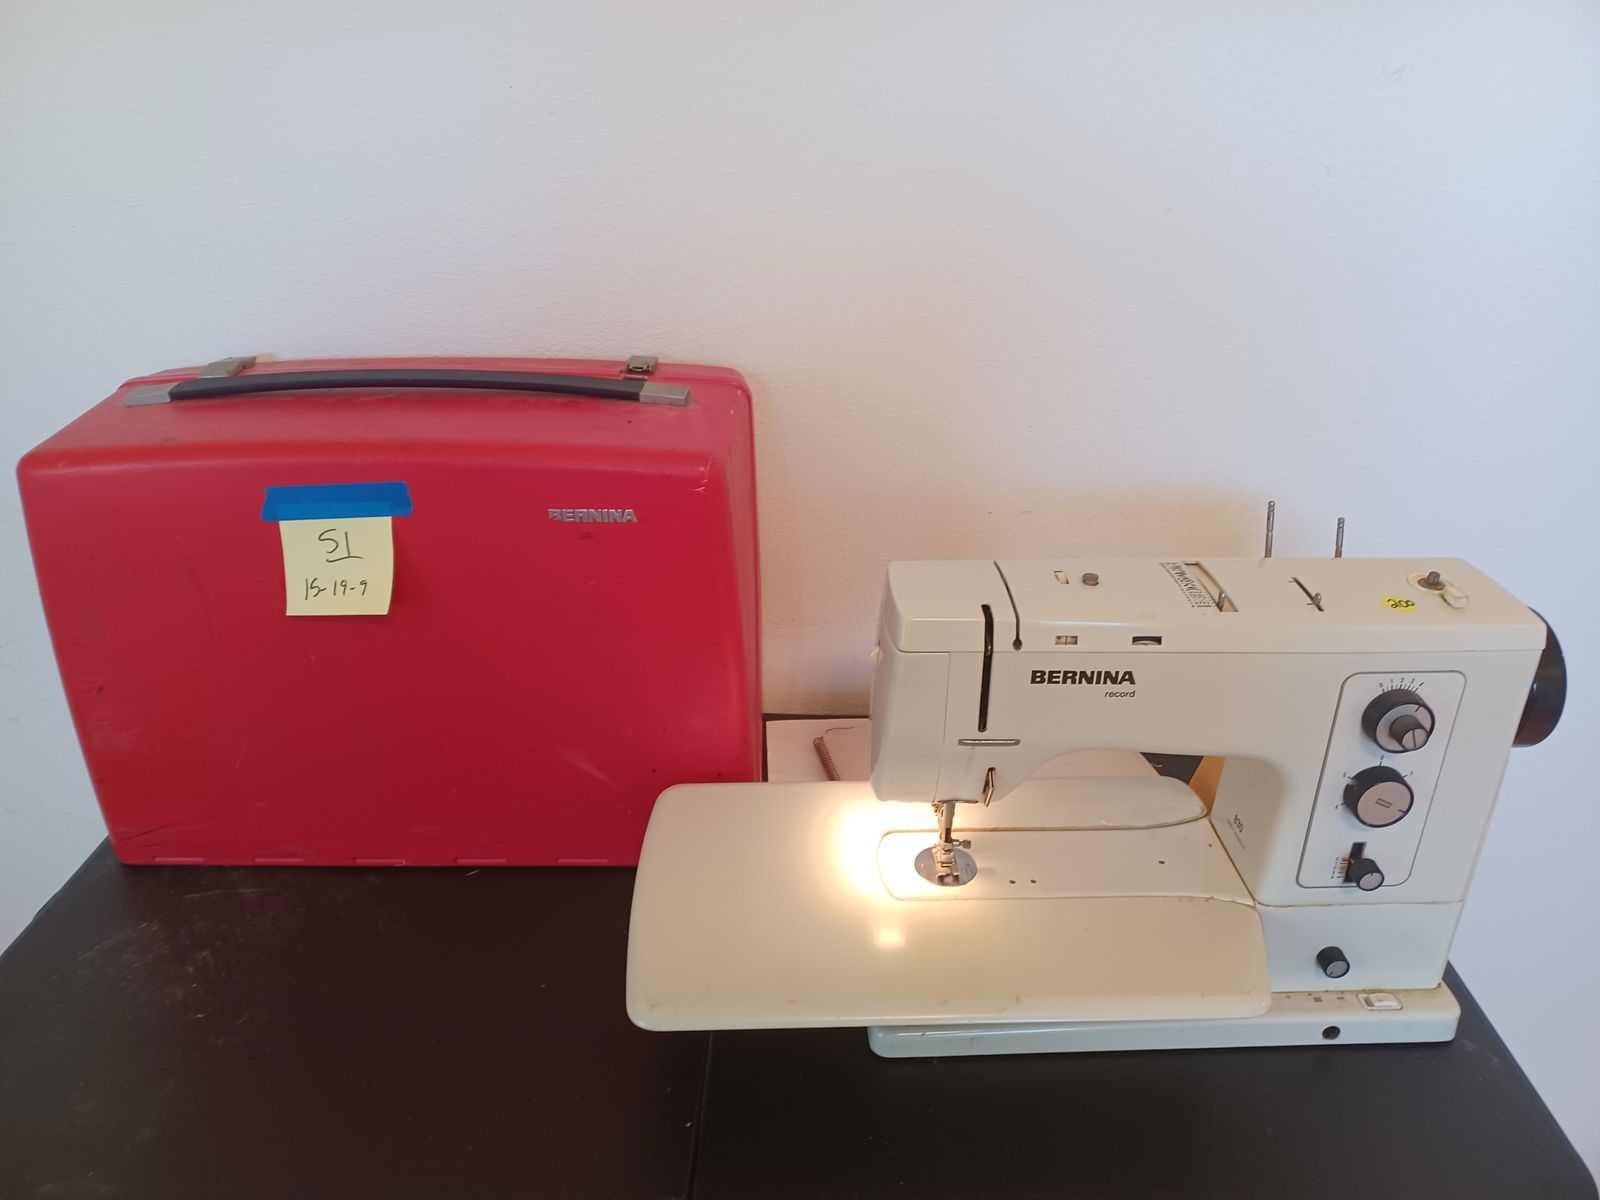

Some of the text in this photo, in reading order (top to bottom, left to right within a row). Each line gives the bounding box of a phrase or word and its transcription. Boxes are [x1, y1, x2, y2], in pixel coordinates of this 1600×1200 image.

[547, 508, 638, 523] BERNINA
[1030, 669, 1136, 685] BERNINA
[1104, 689, 1136, 698] record
